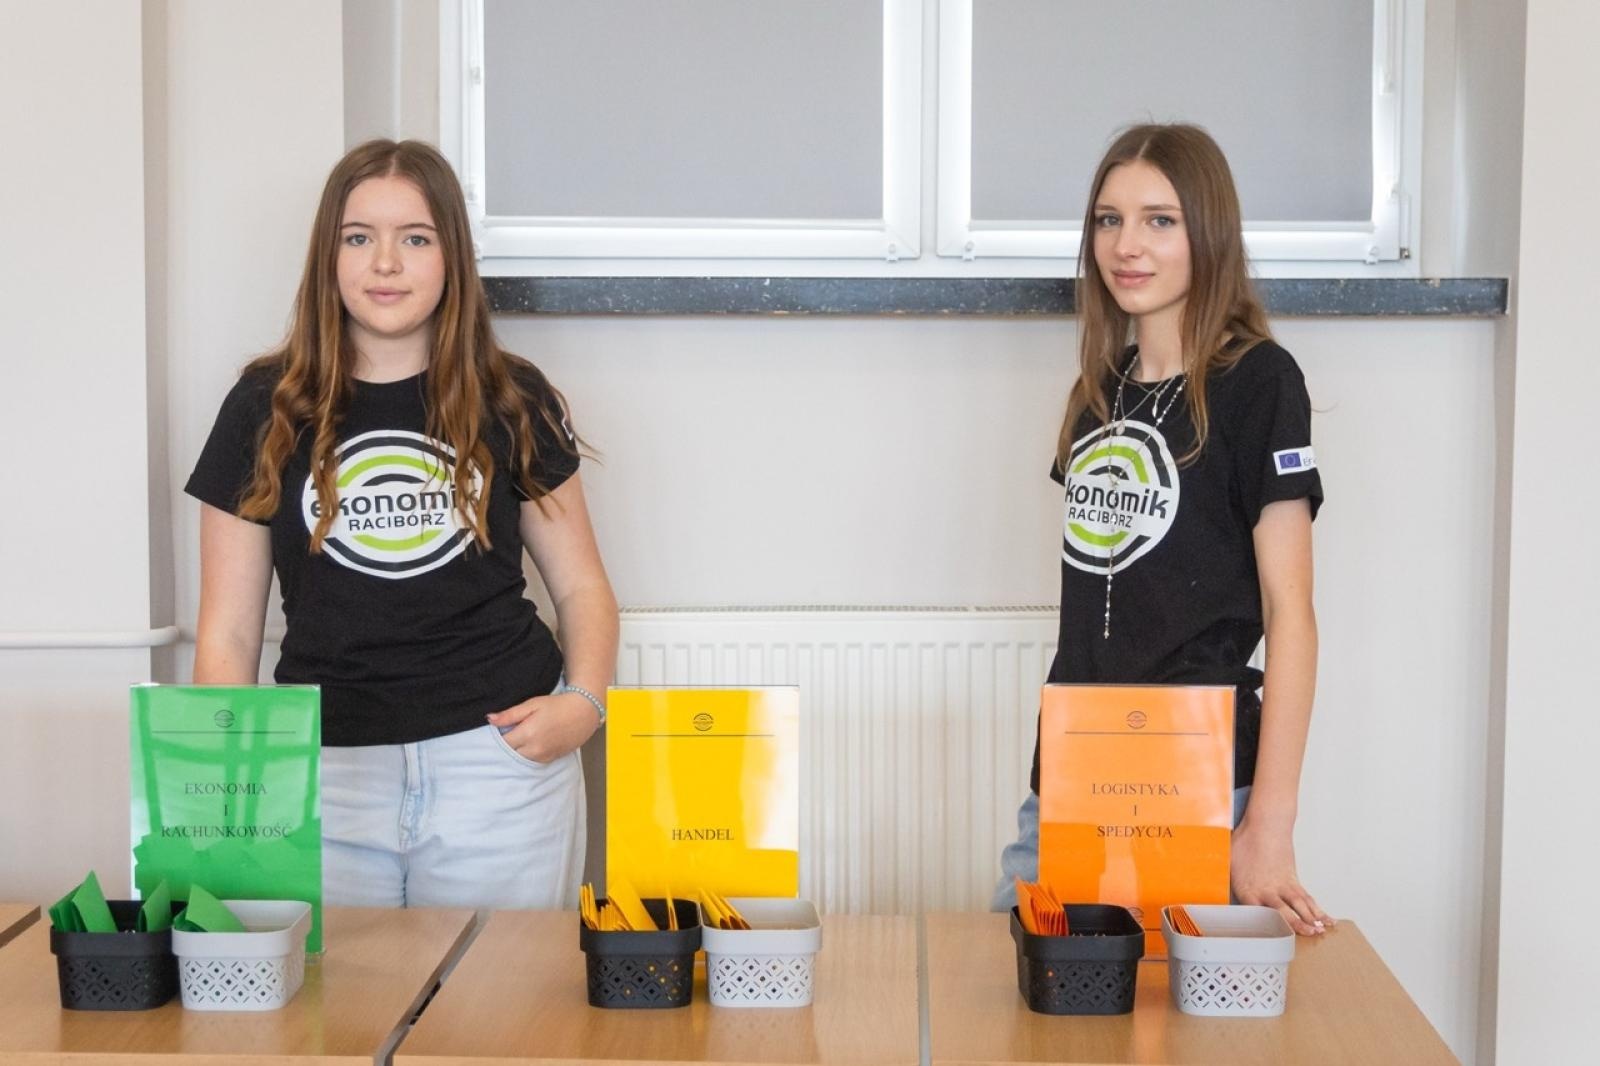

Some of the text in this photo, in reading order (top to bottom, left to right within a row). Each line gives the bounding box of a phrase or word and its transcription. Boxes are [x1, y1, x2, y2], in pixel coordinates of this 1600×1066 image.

[1064, 477, 1169, 519] konomik
[184, 782, 268, 795] EKONOMIA
[1092, 782, 1180, 796] LOGISTYKA
[224, 804, 229, 817] I
[1133, 804, 1138, 817] I
[161, 822, 293, 839] RACHUNKOWOŚĆ
[672, 828, 735, 841] HANDEL
[1097, 825, 1173, 839] SPEDYCJA
